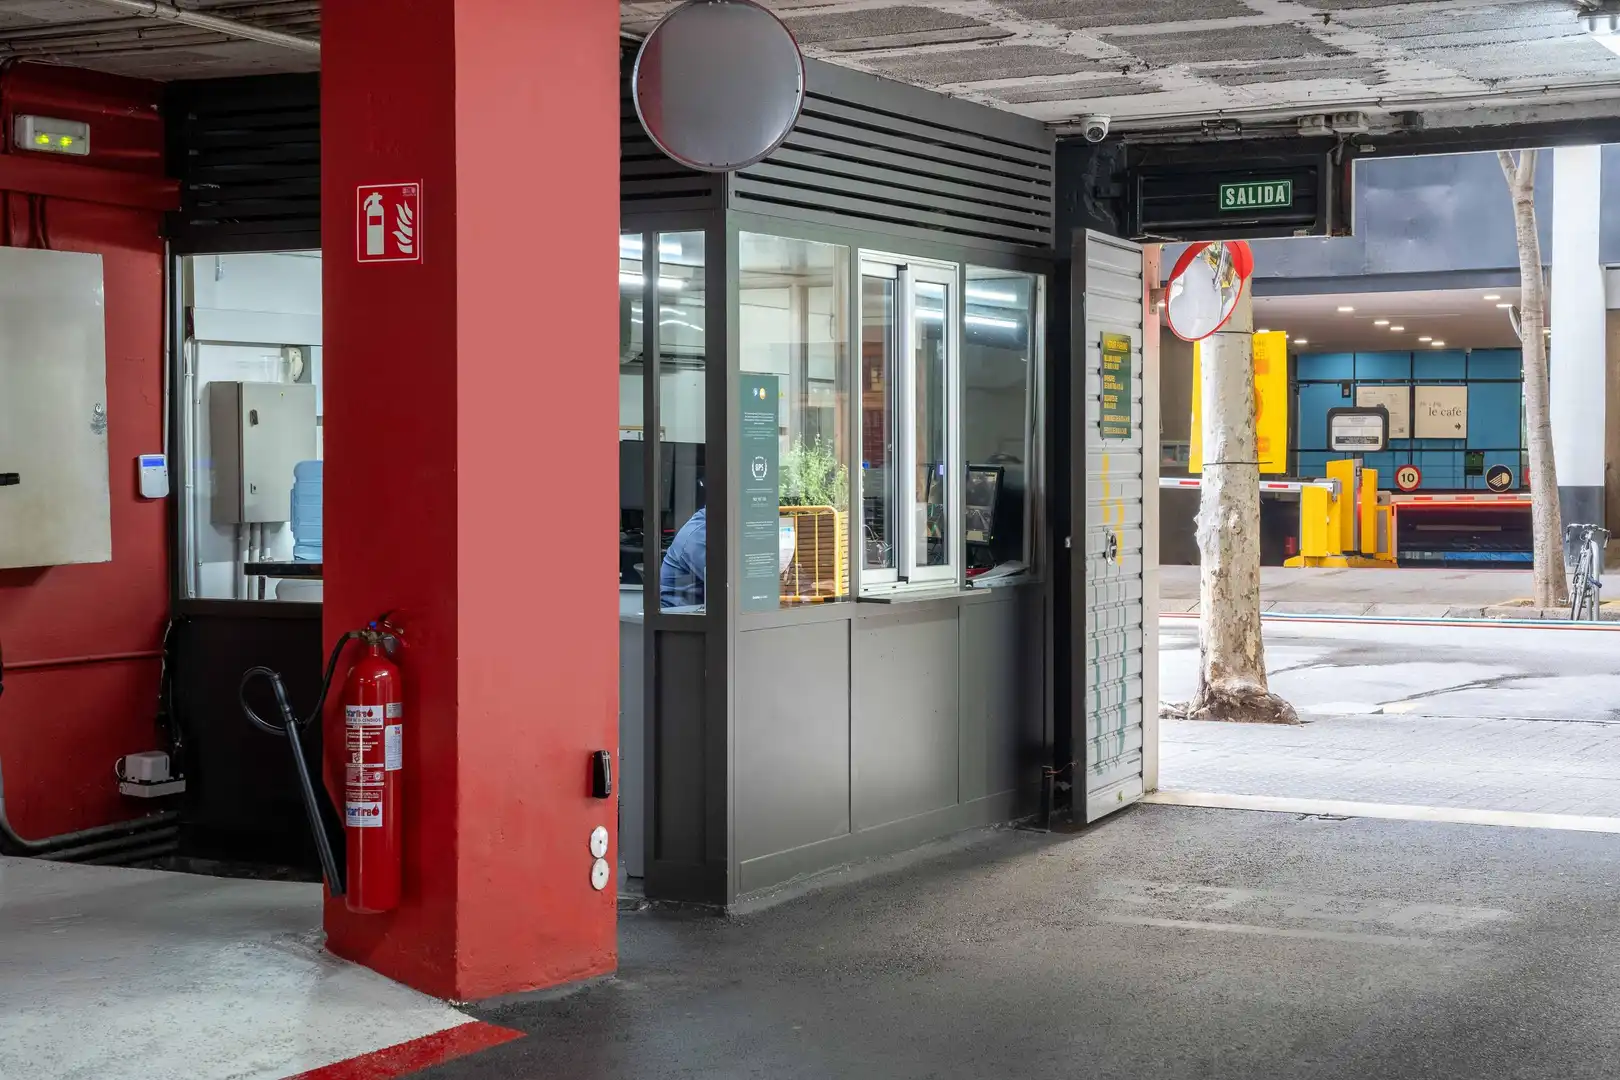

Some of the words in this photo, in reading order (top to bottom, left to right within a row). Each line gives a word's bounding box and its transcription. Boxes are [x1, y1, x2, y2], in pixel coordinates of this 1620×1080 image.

[1225, 185, 1286, 206] SALIDA
[1428, 406, 1438, 417] le
[1440, 405, 1462, 417] café
[1401, 473, 1415, 483] 10
